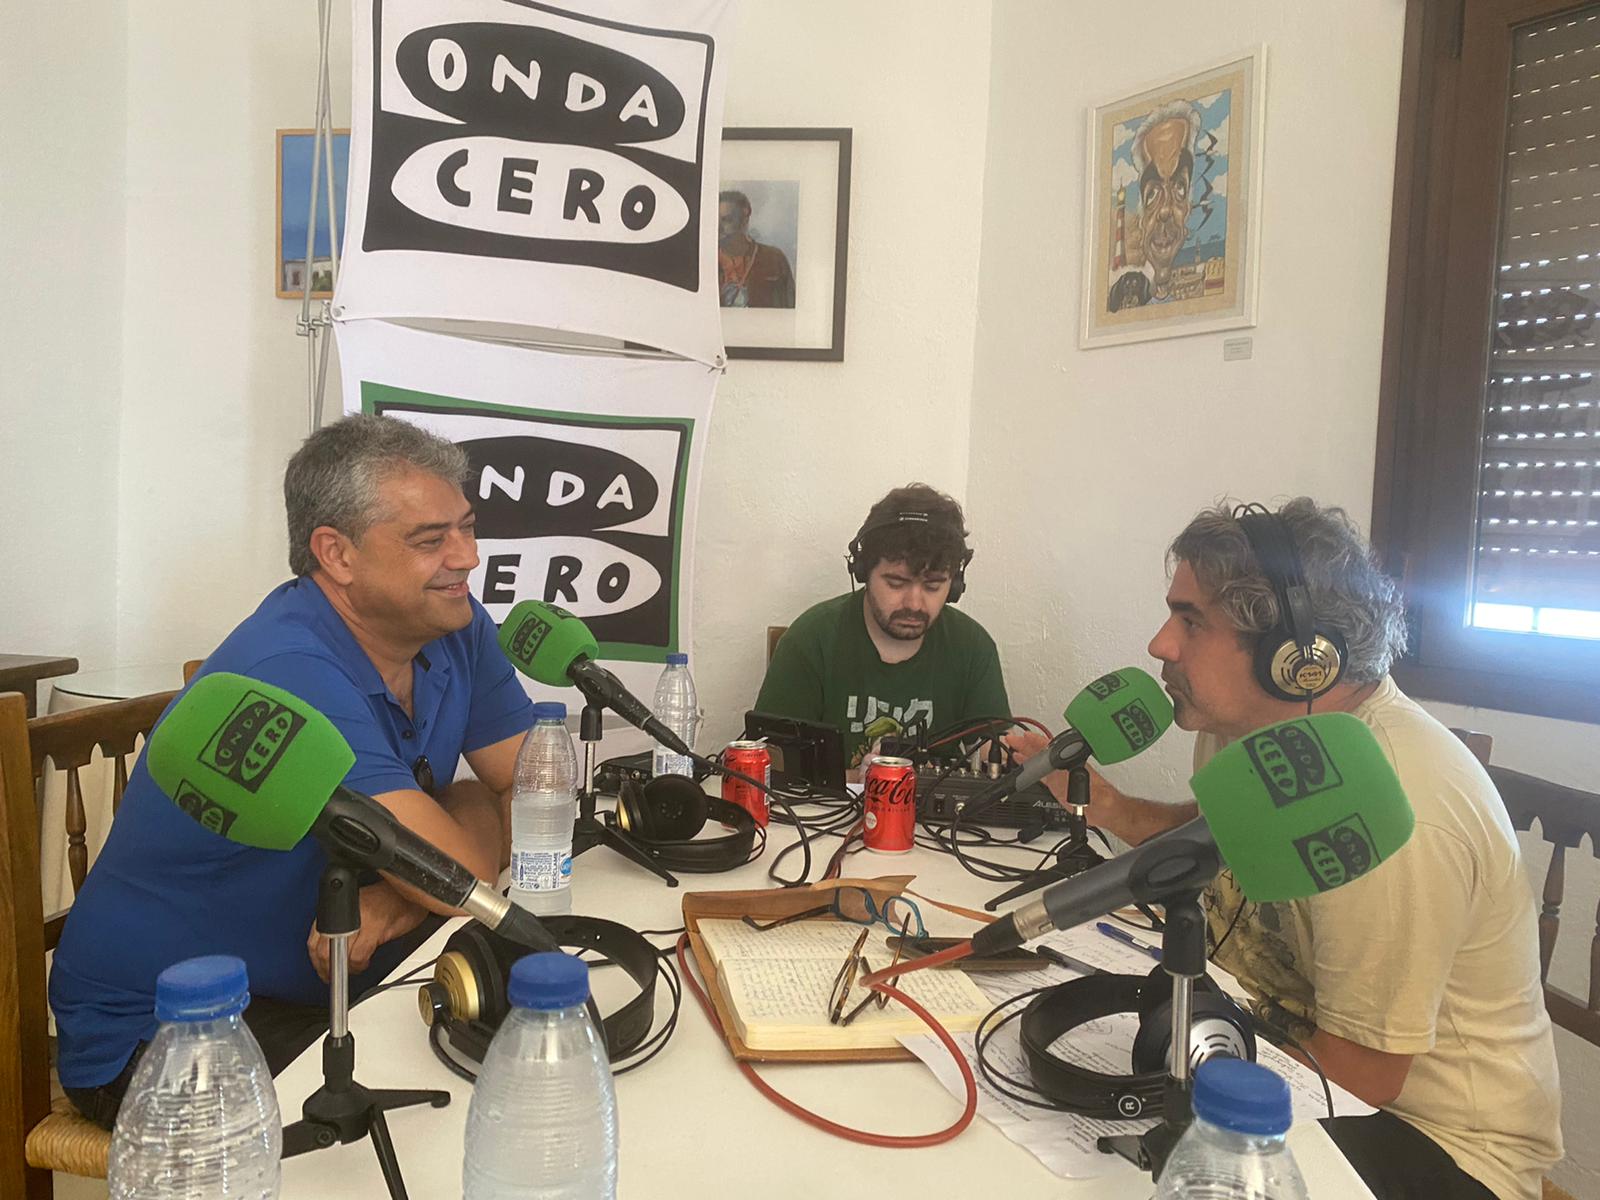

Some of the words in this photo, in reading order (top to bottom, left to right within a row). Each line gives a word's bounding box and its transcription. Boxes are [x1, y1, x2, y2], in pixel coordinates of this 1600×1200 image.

[427, 38, 659, 128] ONDA
[436, 149, 656, 232] CERO
[478, 464, 634, 511] NDA
[482, 554, 631, 604] ERO
[523, 626, 543, 655] CERO
[218, 706, 266, 760] ONDA
[244, 716, 289, 772] CERO
[1286, 729, 1319, 778] ONDA
[1259, 740, 1294, 788] CERO
[1125, 1101, 1135, 1111] R
